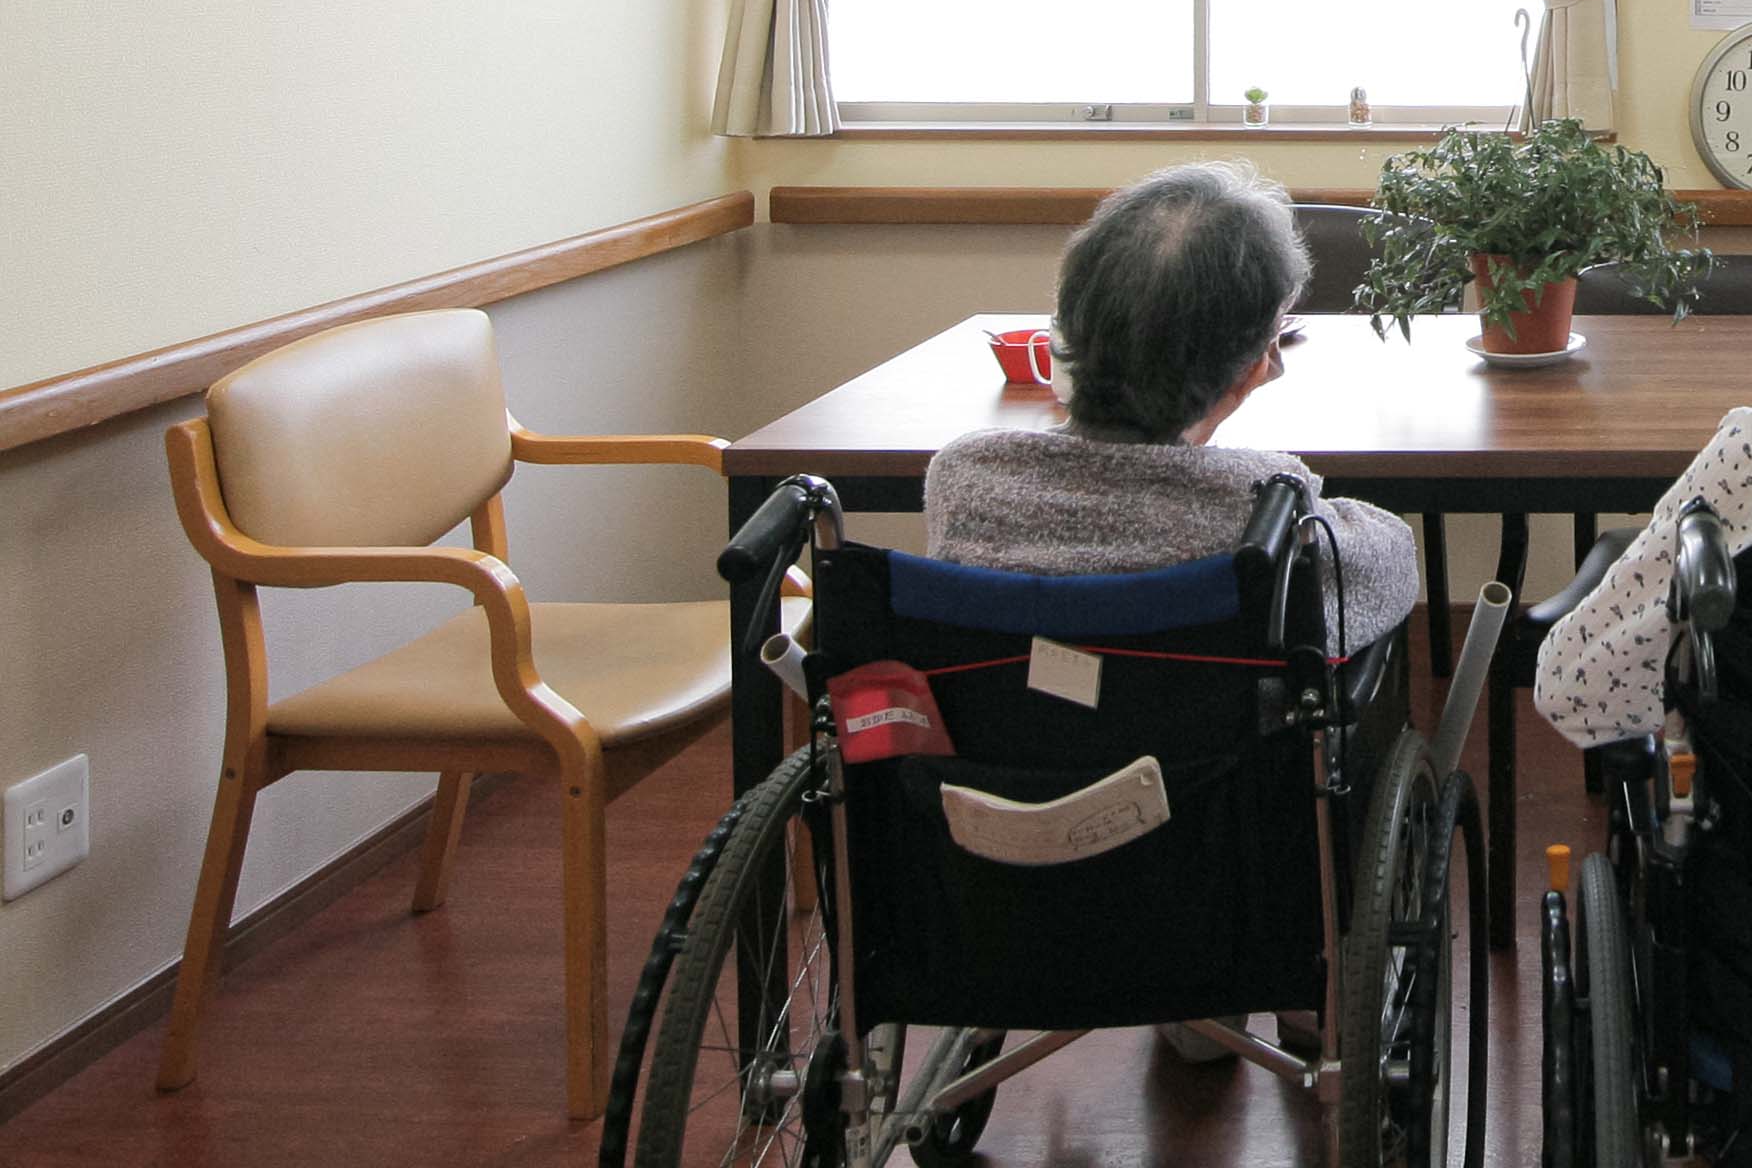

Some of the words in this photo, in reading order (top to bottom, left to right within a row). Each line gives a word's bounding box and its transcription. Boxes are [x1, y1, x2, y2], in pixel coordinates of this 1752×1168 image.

[1727, 71, 1747, 91] 10
[1716, 101, 1730, 121] 9
[1725, 131, 1739, 152] 8
